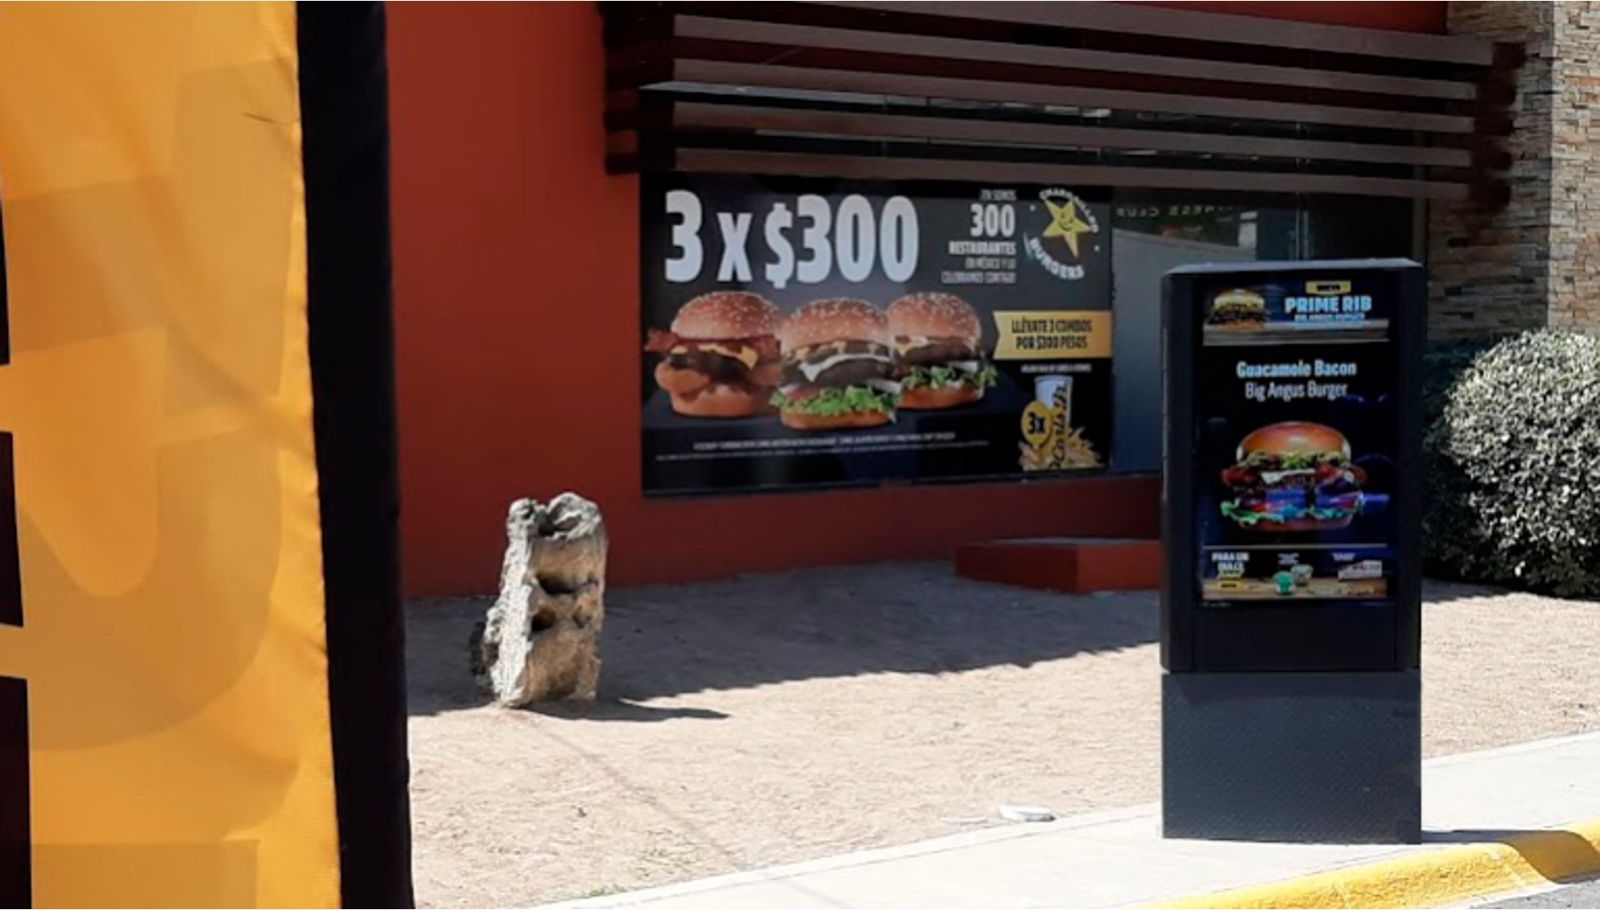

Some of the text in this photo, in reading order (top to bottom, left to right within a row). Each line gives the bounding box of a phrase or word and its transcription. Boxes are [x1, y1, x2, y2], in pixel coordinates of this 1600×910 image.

[969, 203, 1016, 238] 300
[665, 190, 702, 282] 3
[764, 193, 920, 289] $300
[948, 241, 1017, 256] RESTAURANTES
[1029, 236, 1085, 280] BURGERS
[1285, 295, 1372, 314] PRIME RIB
[1015, 336, 1034, 349] POR
[1236, 359, 1357, 378] Guacamole Bacon
[1245, 380, 1348, 401] Big Angus Burger
